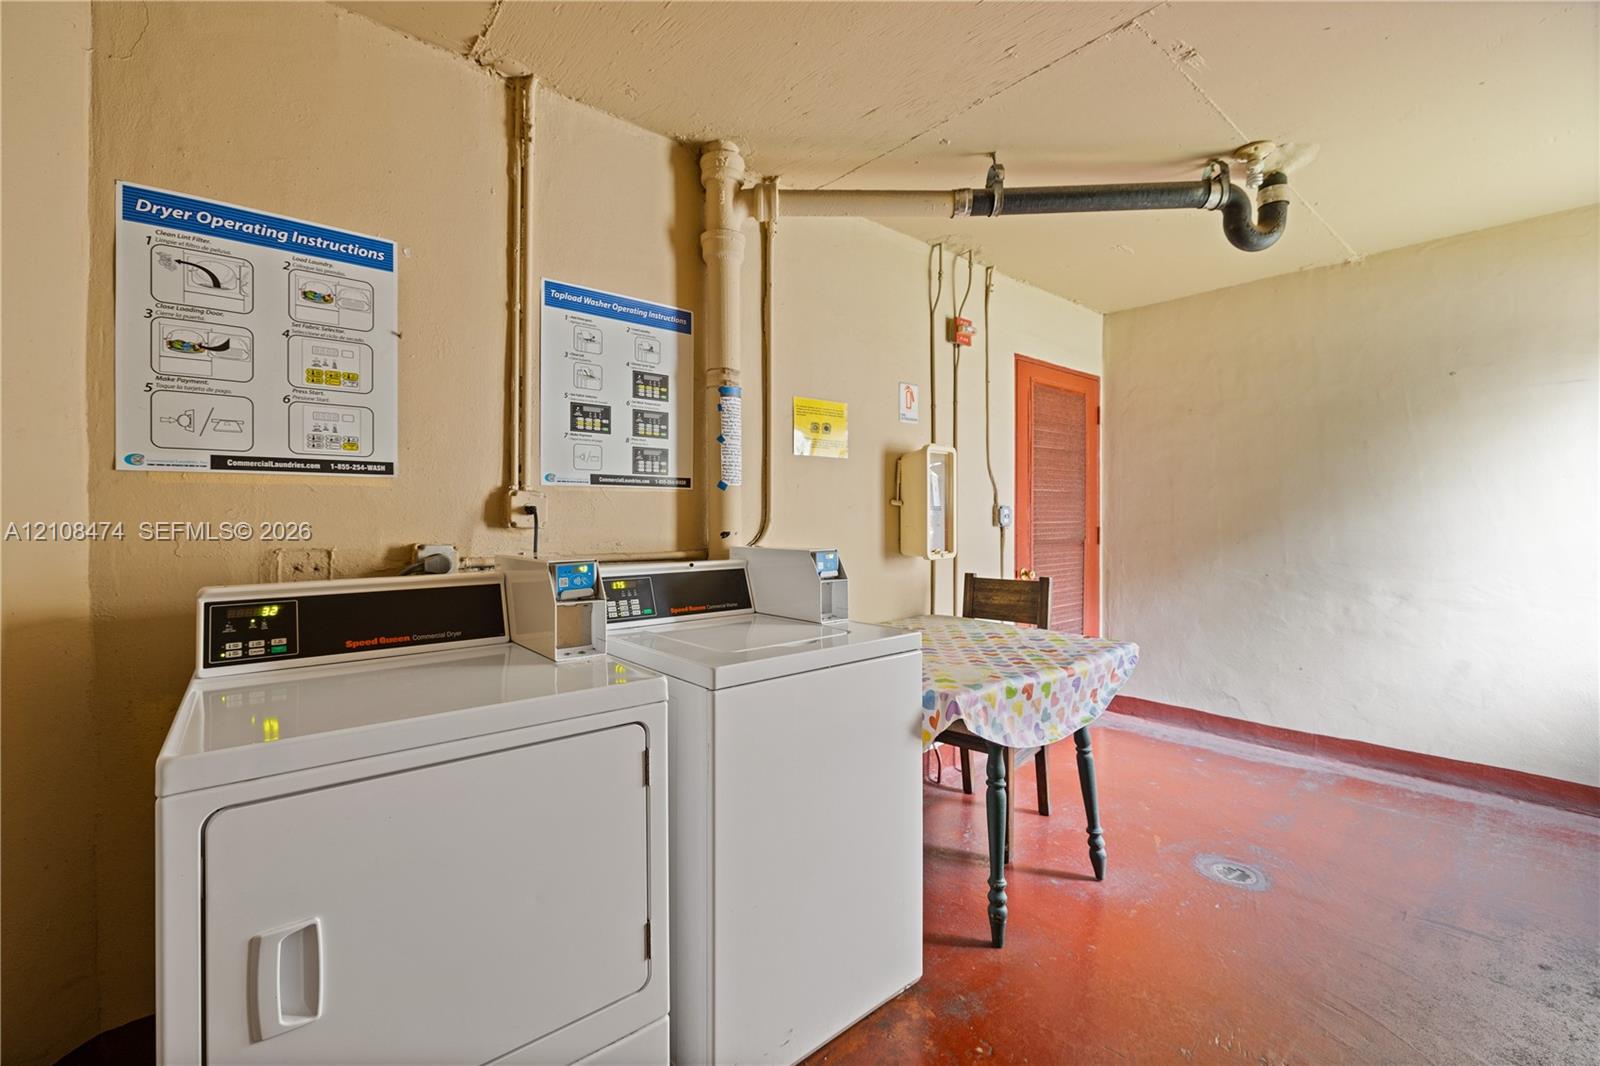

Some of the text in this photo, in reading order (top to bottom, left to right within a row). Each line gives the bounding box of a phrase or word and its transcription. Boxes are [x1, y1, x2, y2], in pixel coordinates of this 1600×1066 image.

[135, 199, 385, 260] Dryer Operating Instructions
[146, 236, 151, 245] 1
[155, 229, 212, 244] Clean Lint Filter.
[155, 237, 178, 246] Limpie
[185, 241, 201, 249] filtro
[282, 261, 291, 270] 2
[292, 255, 333, 268] Load Laundry.
[155, 302, 224, 317] Close Loading Door.
[550, 289, 687, 325] Topload Washer Operating Instructions
[144, 308, 153, 318] 3
[282, 329, 289, 338] 4
[144, 382, 153, 392] 5
[176, 377, 209, 386] Payment.
[283, 394, 291, 404] 6
[227, 458, 386, 472] CommercialLaundries.com 1-855-254-WASH
[261, 605, 279, 616] 32
[345, 630, 462, 649] Speed Queen Commercial Dryer
